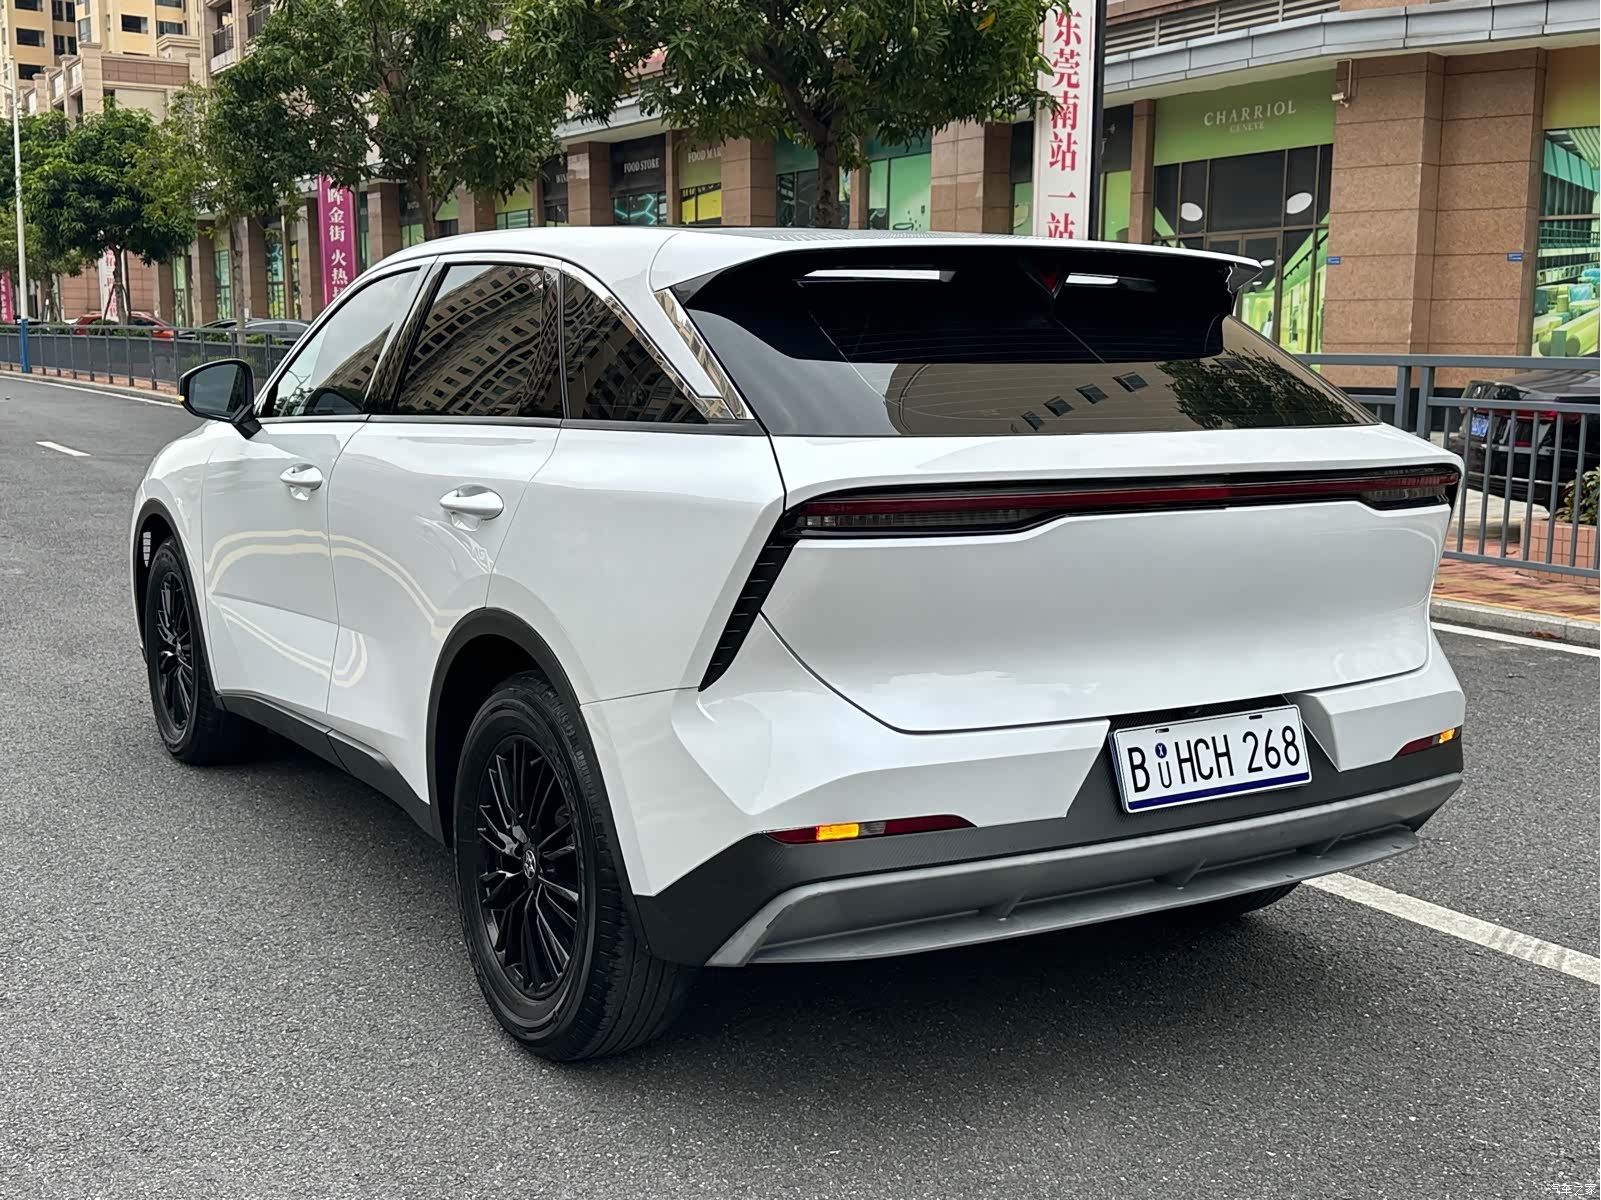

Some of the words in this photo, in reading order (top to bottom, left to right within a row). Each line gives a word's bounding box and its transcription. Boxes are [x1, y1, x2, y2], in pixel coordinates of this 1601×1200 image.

[1203, 100, 1296, 126] CHARRIOL
[624, 160, 640, 173] FOOD
[640, 157, 660, 171] STORE
[688, 150, 706, 163] FOOD
[1242, 725, 1300, 773] 268
